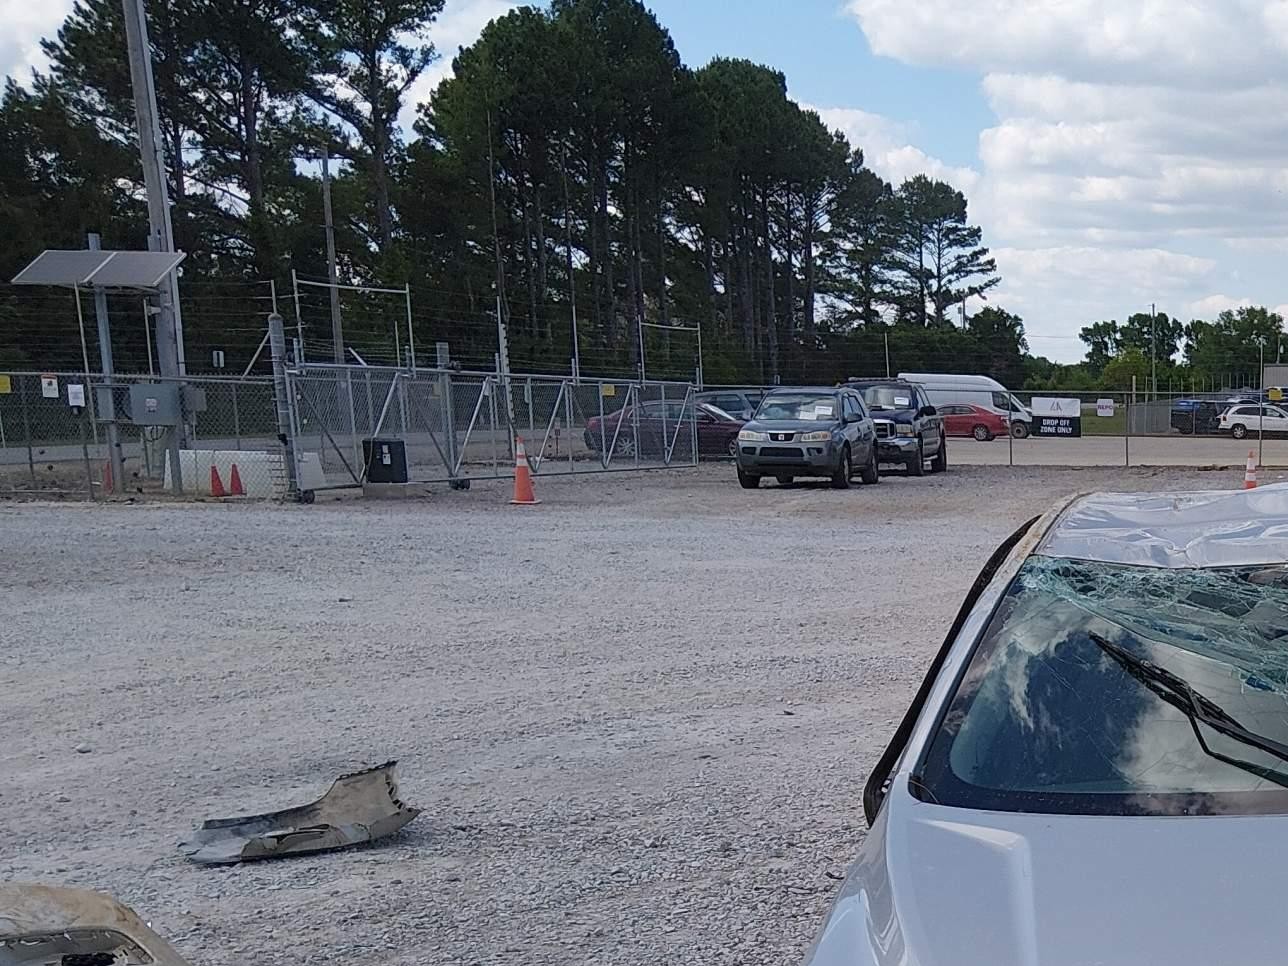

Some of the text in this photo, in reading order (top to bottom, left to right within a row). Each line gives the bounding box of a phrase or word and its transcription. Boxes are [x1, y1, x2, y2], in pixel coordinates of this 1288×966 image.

[1042, 418, 1070, 427] DROP OFF
[1040, 426, 1057, 434] ZONE
